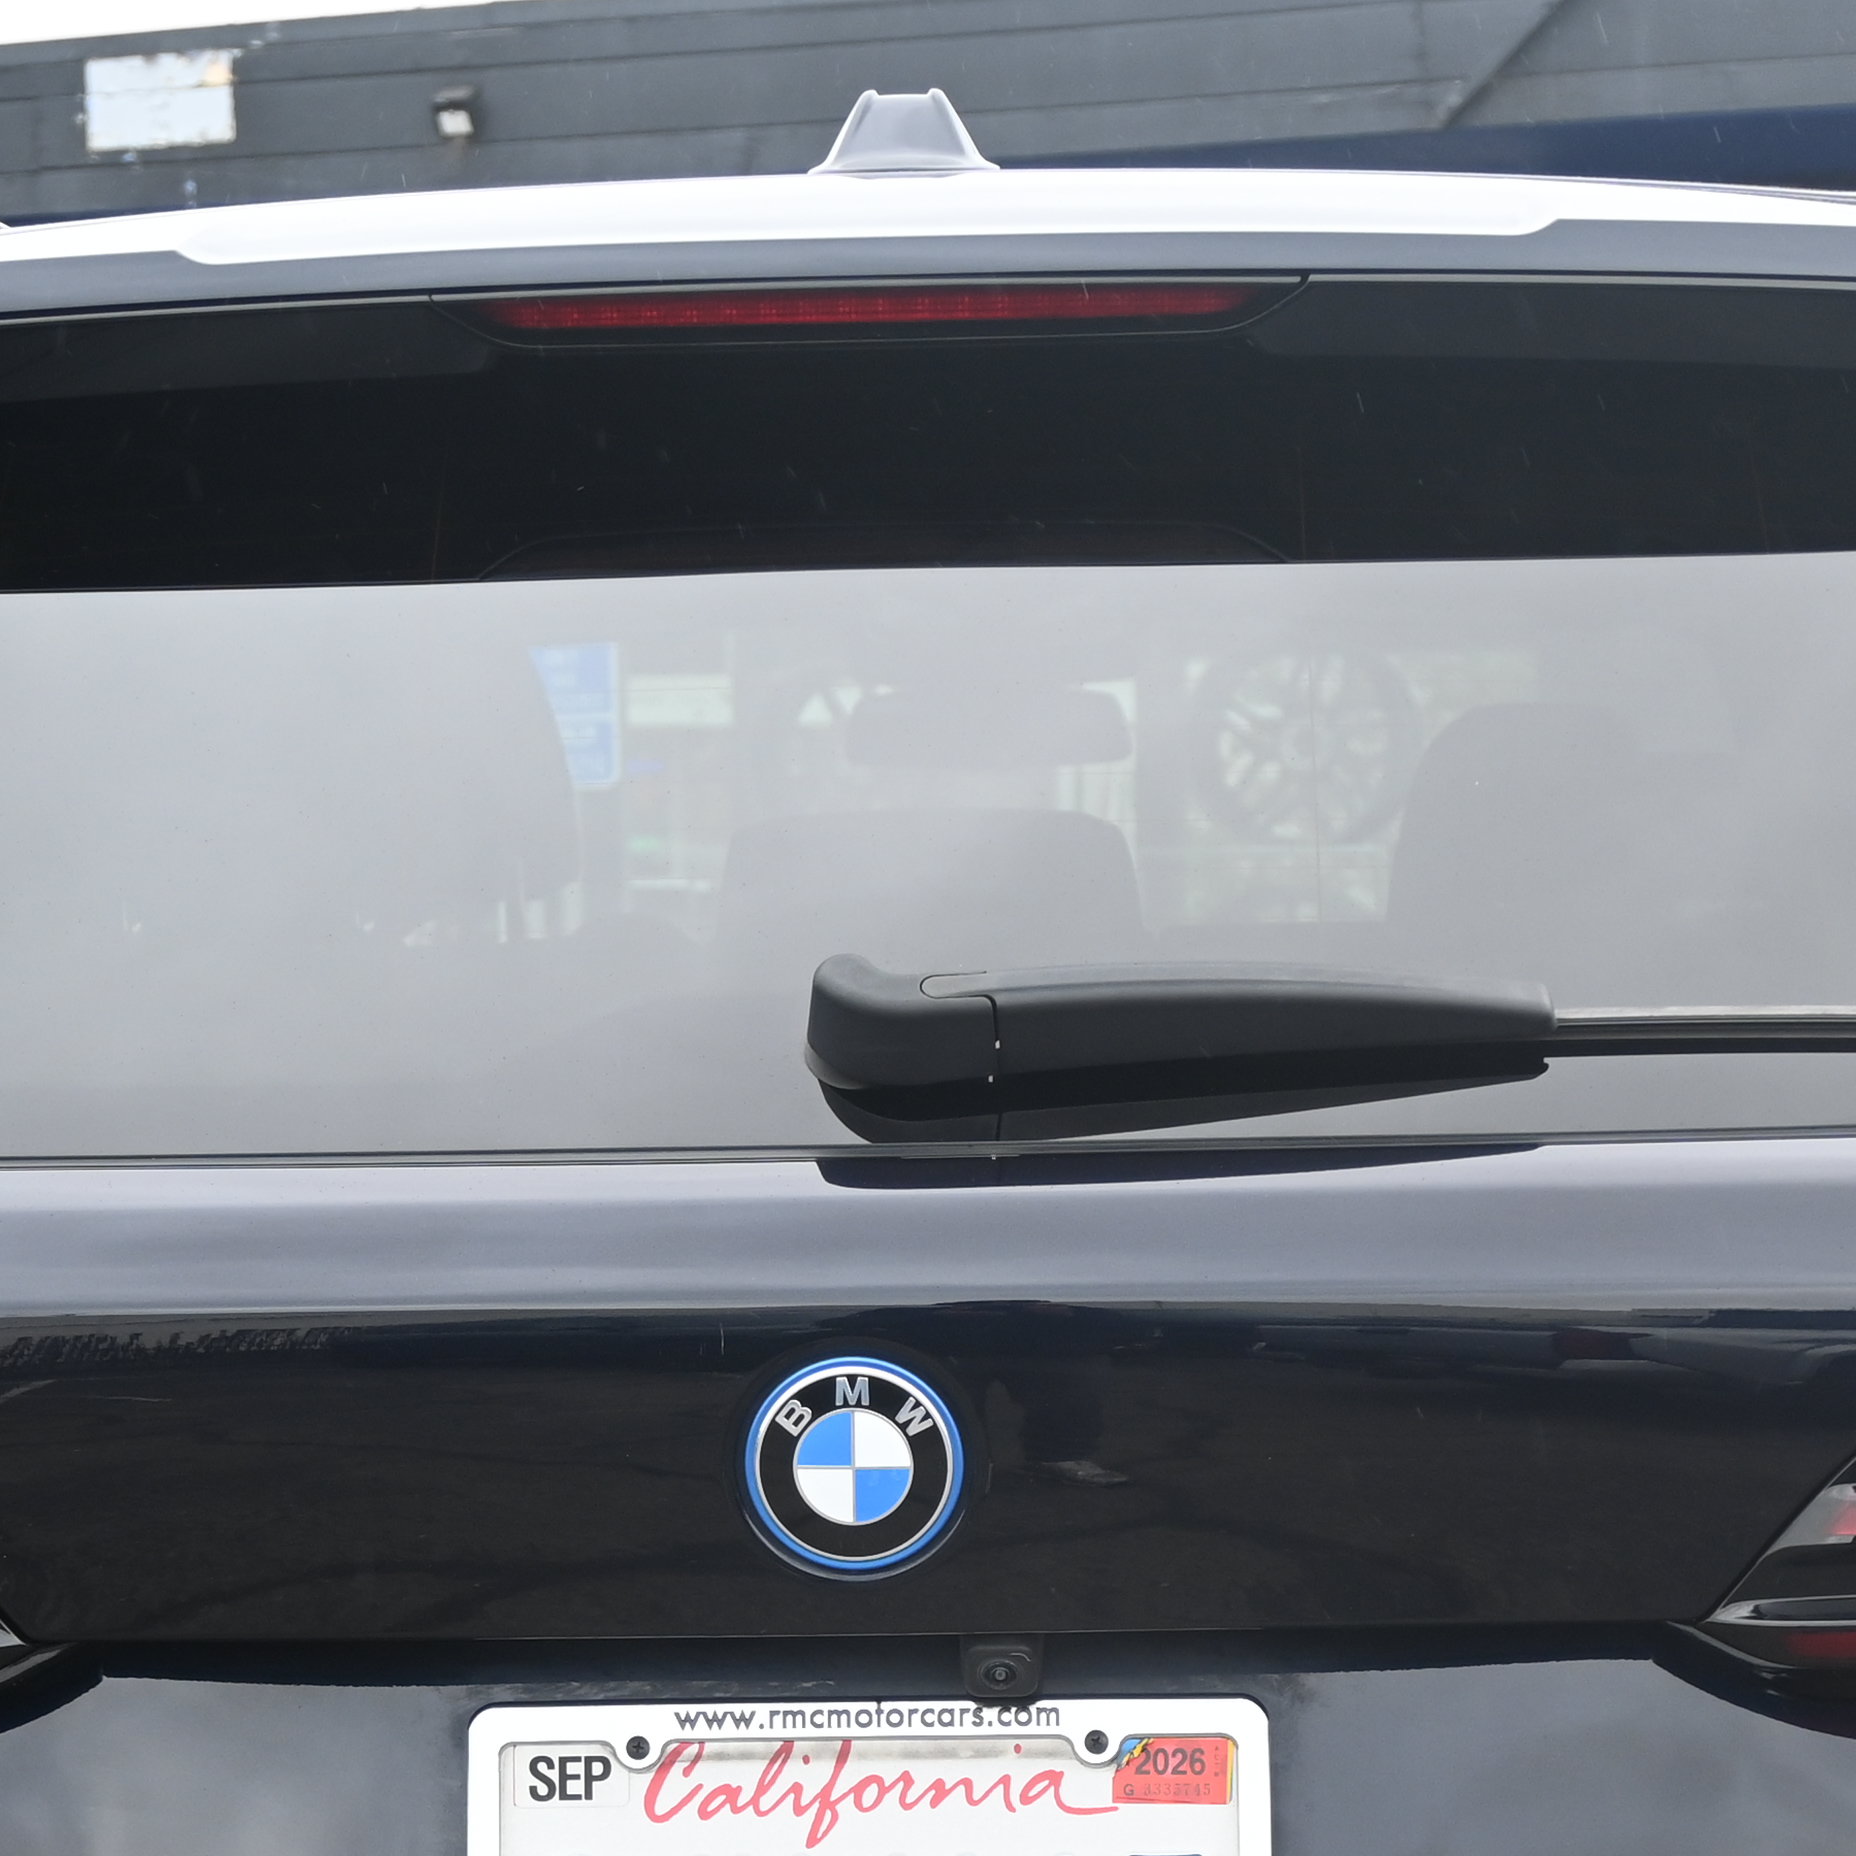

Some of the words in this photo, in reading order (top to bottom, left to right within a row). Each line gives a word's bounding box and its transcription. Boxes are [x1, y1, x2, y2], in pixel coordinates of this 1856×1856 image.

[775, 1376, 934, 1437] BMW
[674, 1704, 1061, 1731] www.rmcmotorcars.com
[528, 1755, 612, 1803] SEP
[1134, 1747, 1207, 1776] 2026
[643, 1740, 1119, 1849] California
